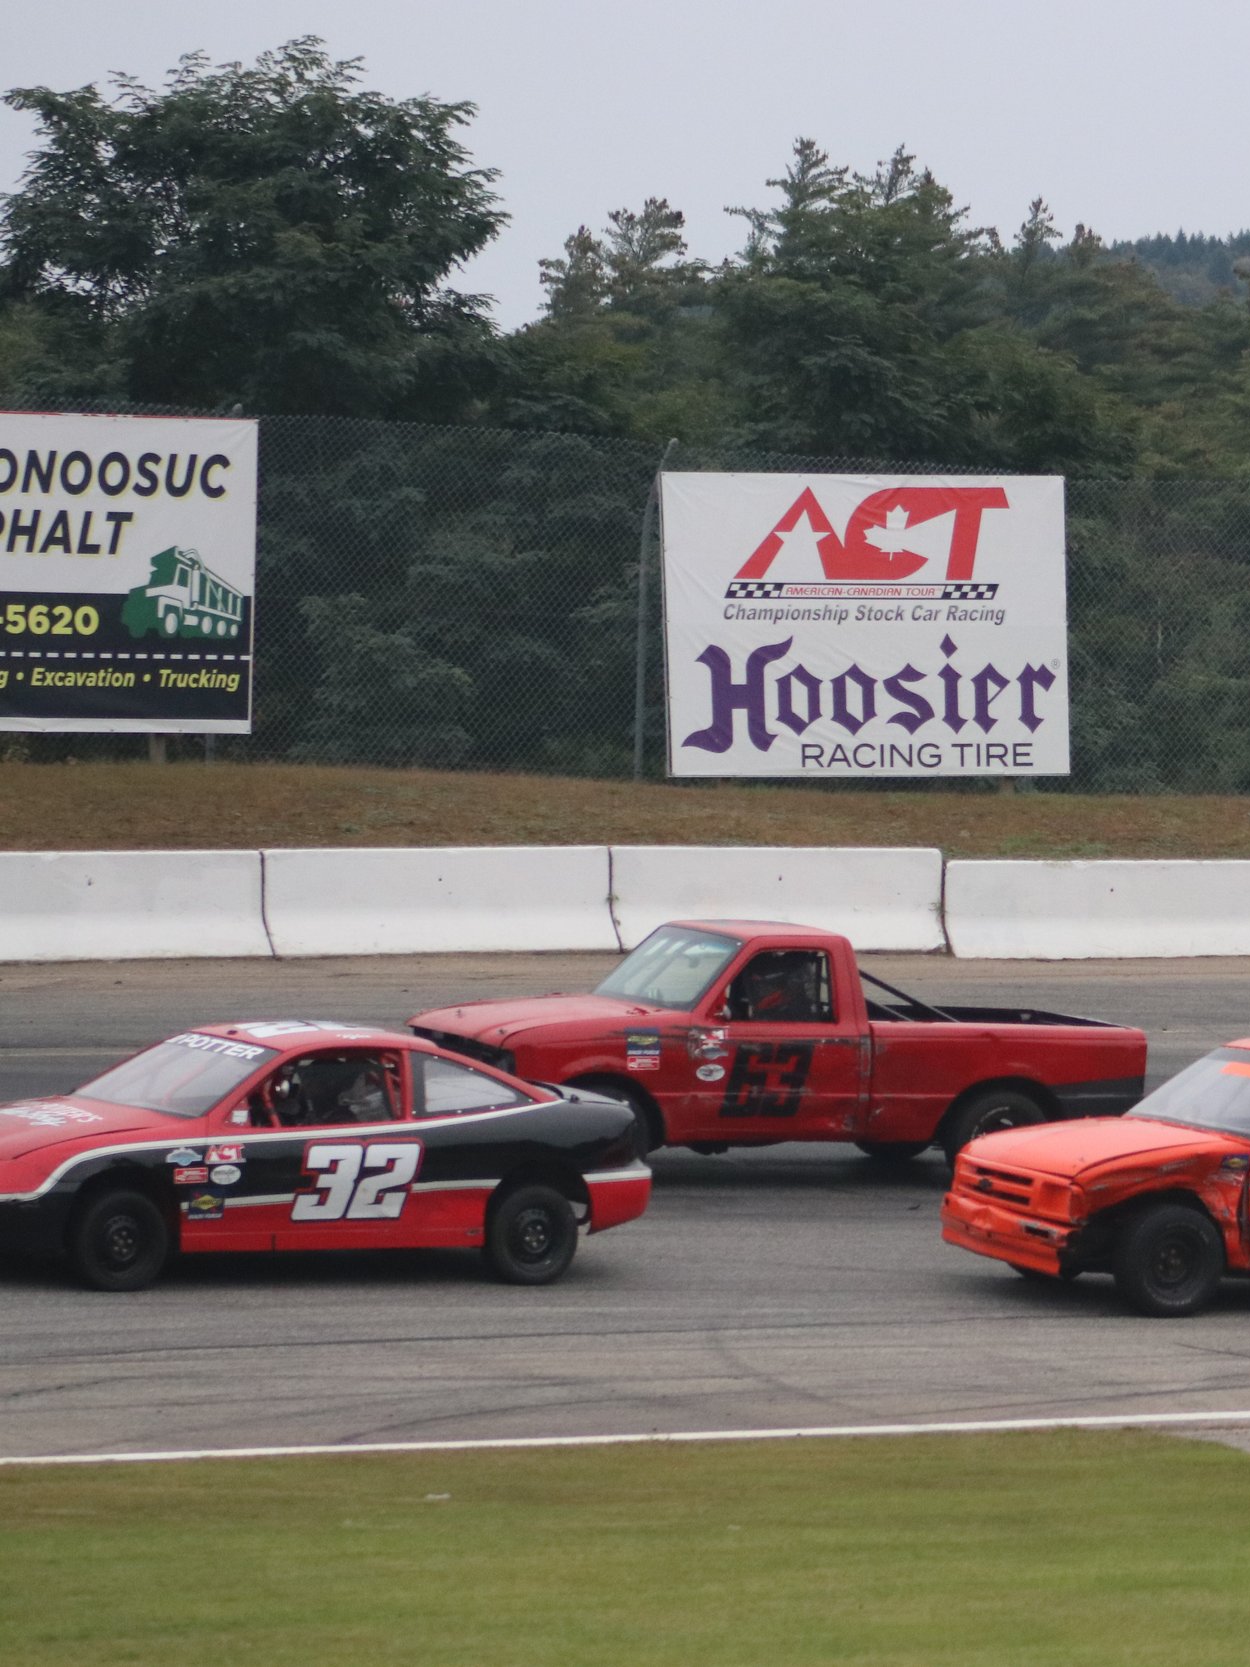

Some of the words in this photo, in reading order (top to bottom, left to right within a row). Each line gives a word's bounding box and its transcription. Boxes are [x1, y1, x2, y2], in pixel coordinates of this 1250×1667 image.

[0, 508, 134, 555] HALT
[733, 485, 1010, 581] ACT
[785, 587, 902, 597] AMERICAN-CANADIAN
[906, 587, 936, 597] TOUR
[723, 603, 849, 625] Championship
[854, 604, 905, 622] Stock
[911, 605, 941, 622] Car
[946, 605, 1006, 626] Racing
[30, 667, 136, 688] Excavation
[159, 668, 240, 692] Trucking
[681, 633, 1056, 754] Hoosier
[801, 743, 942, 769] RACING
[951, 743, 1034, 768] TIRE
[177, 1034, 265, 1060] POTTER
[718, 1041, 816, 1118] 63
[291, 1142, 421, 1221] 32
